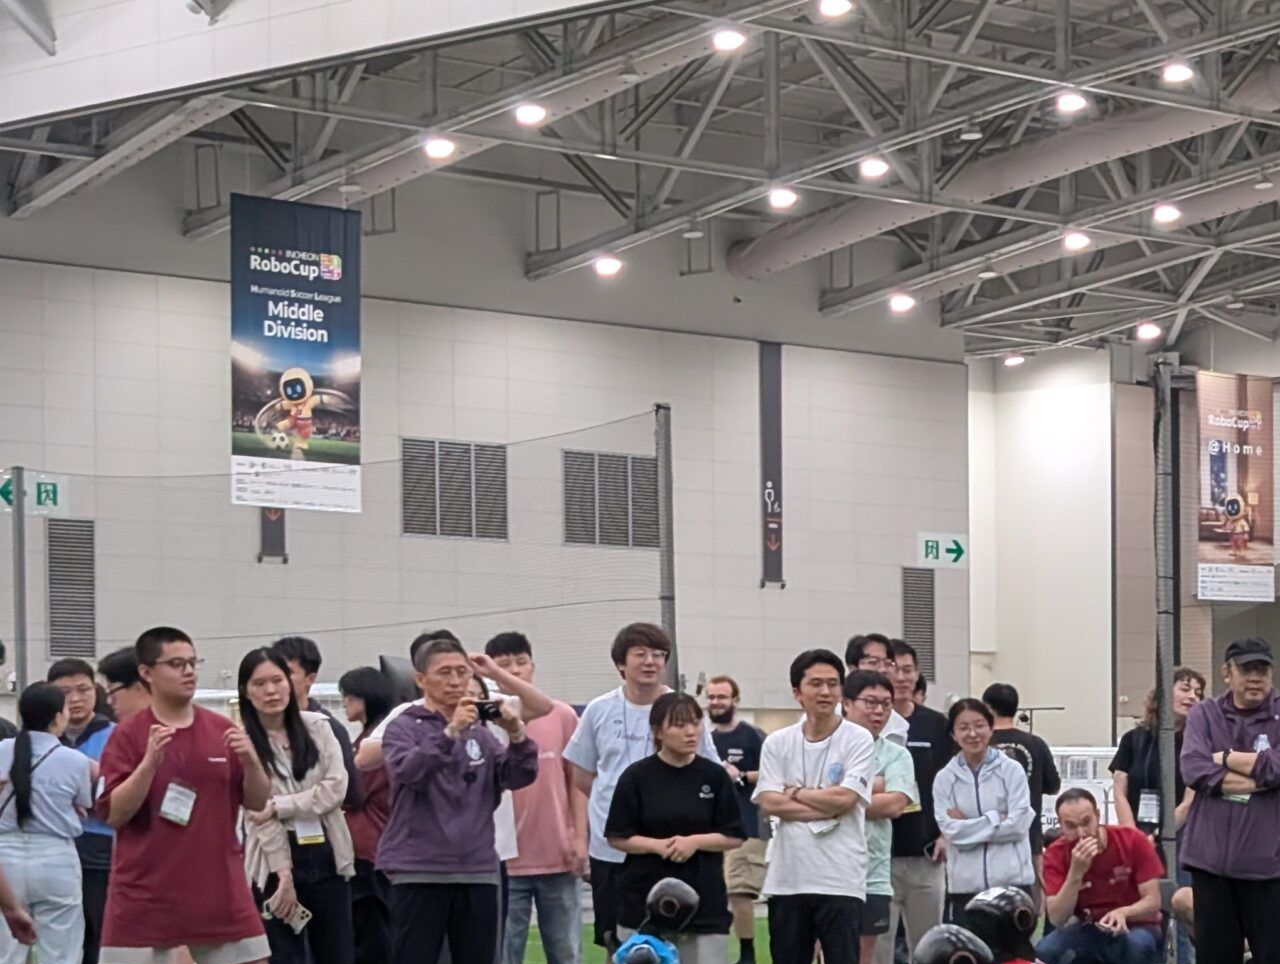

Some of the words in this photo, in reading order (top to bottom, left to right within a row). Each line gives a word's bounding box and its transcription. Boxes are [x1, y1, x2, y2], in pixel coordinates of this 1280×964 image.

[250, 254, 319, 281] RoboCup
[268, 300, 324, 322] Middle
[264, 320, 329, 343] Division
[1208, 414, 1249, 431] RoboCup
